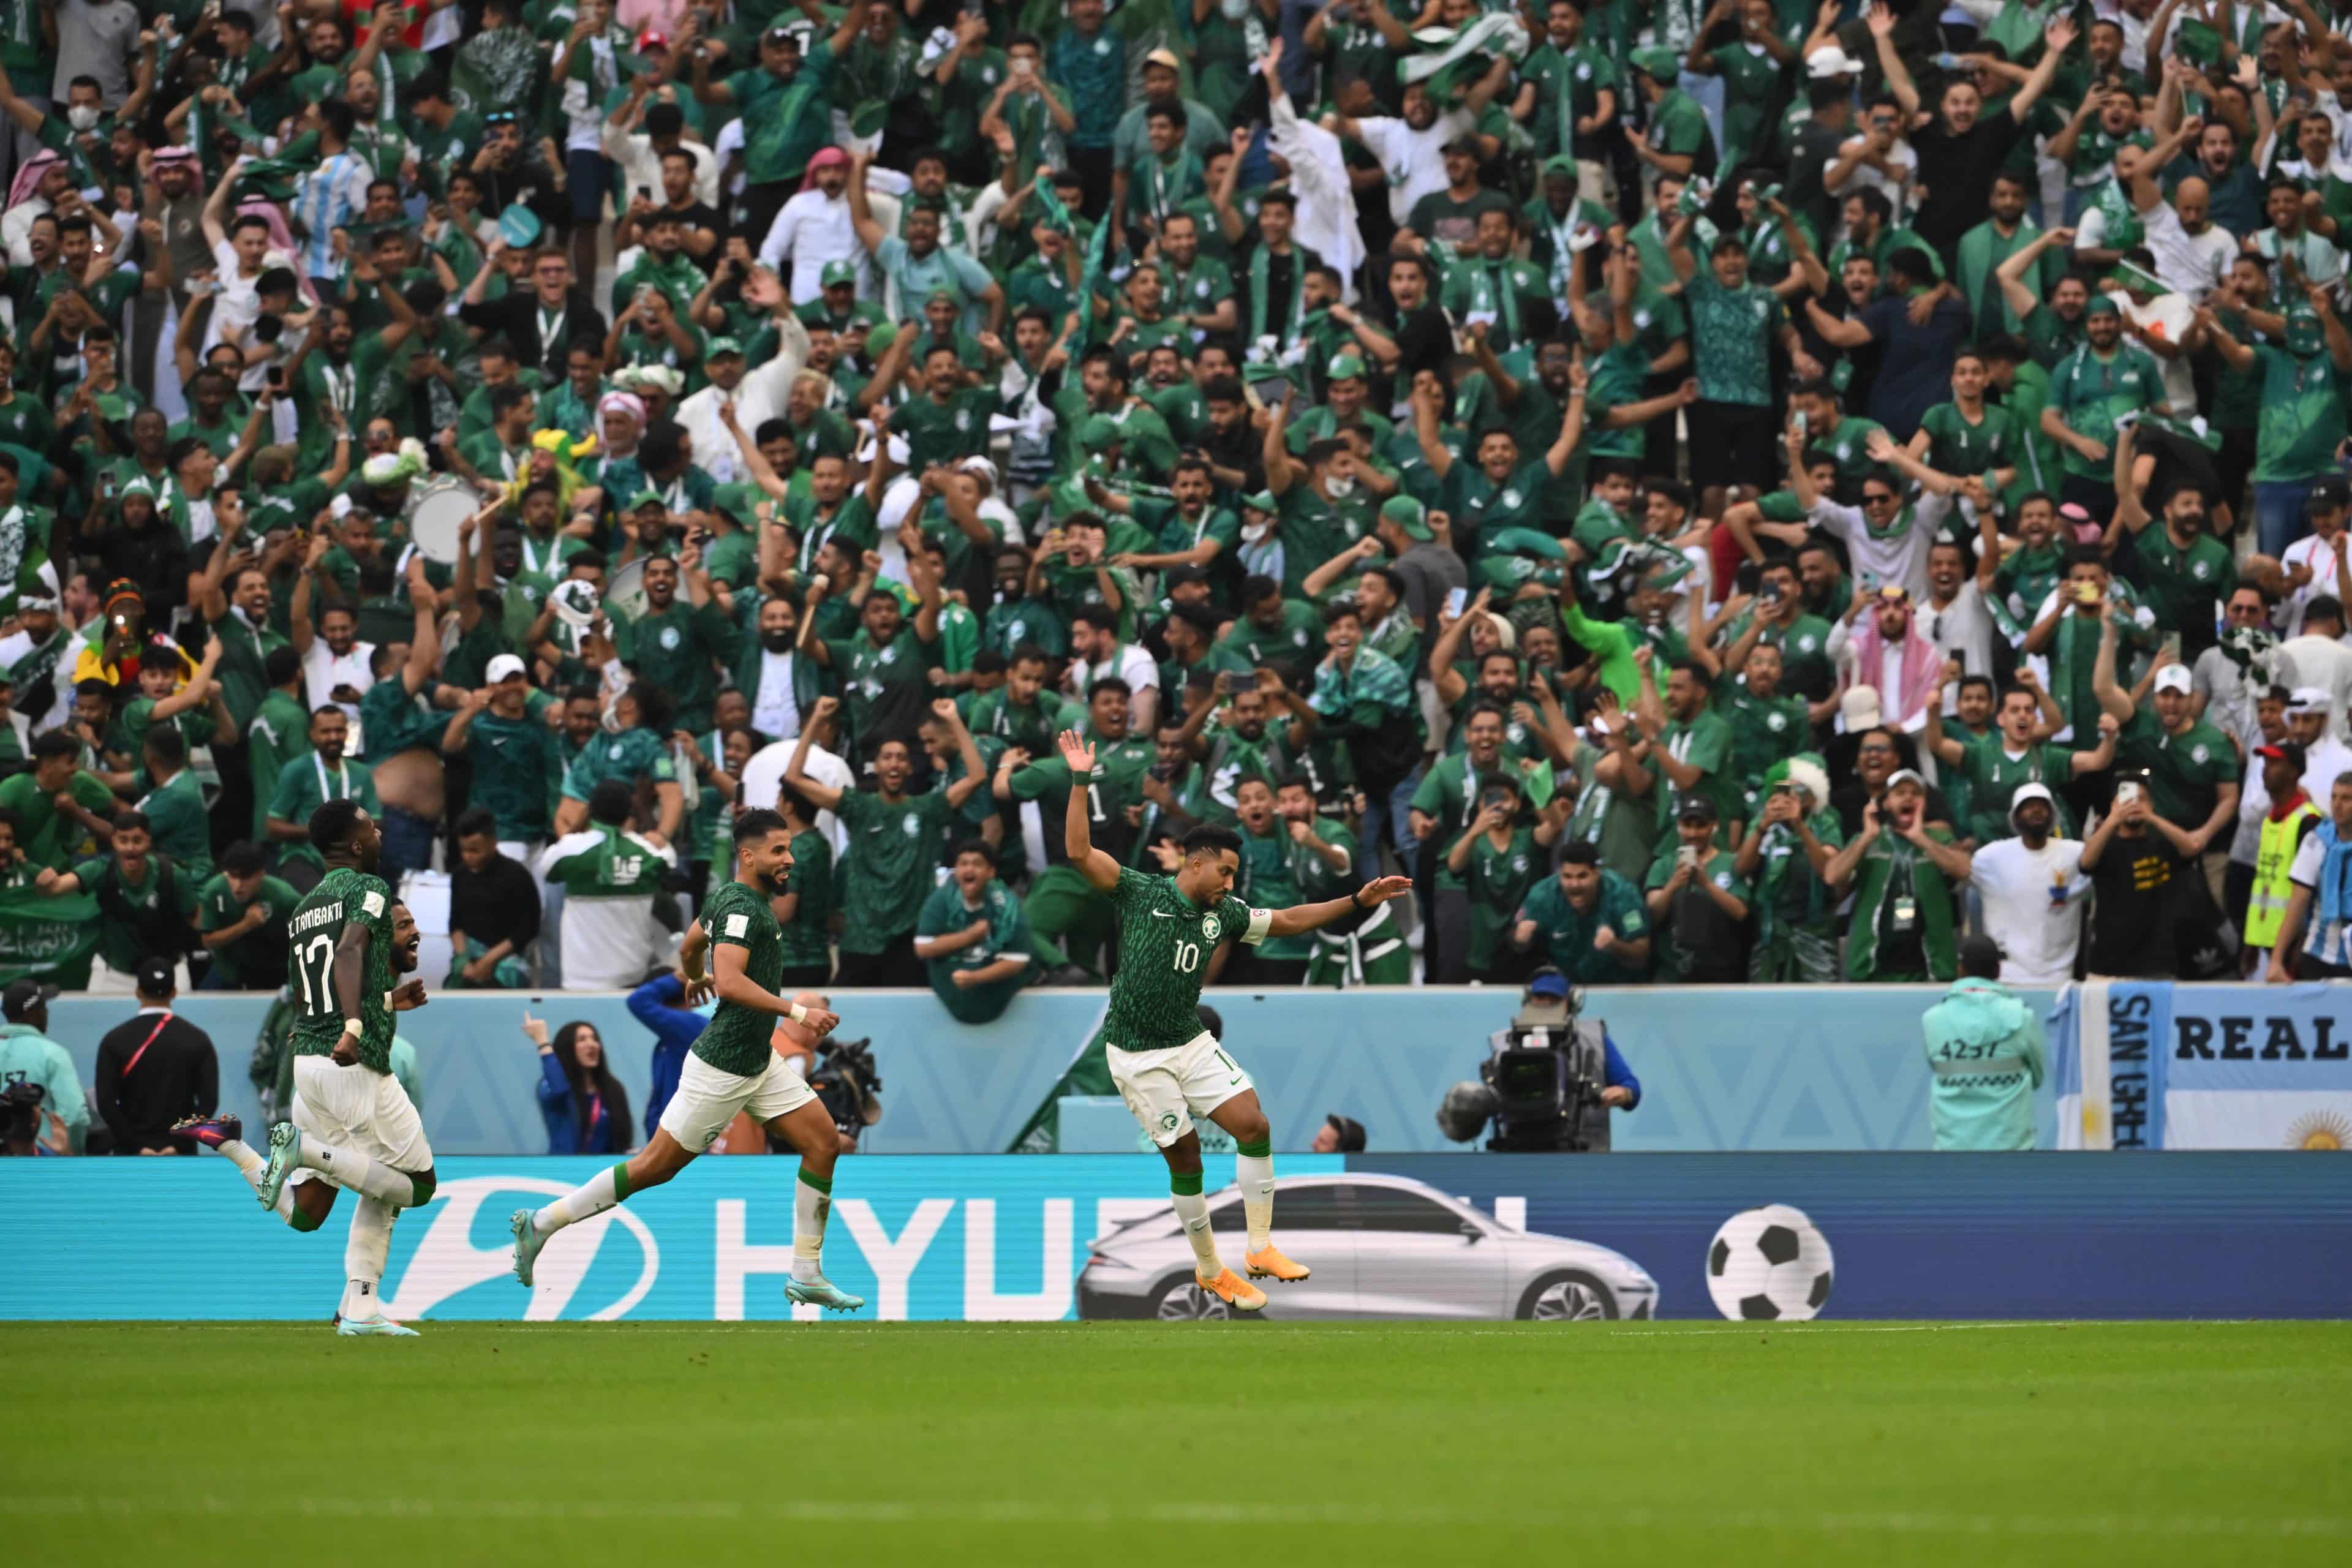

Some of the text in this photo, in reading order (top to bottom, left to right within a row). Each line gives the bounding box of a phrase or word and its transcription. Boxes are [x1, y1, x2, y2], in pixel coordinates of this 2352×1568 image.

[294, 934, 334, 1016] 17
[1174, 940, 1199, 973] 10
[2175, 1016, 2349, 1060] REAL
